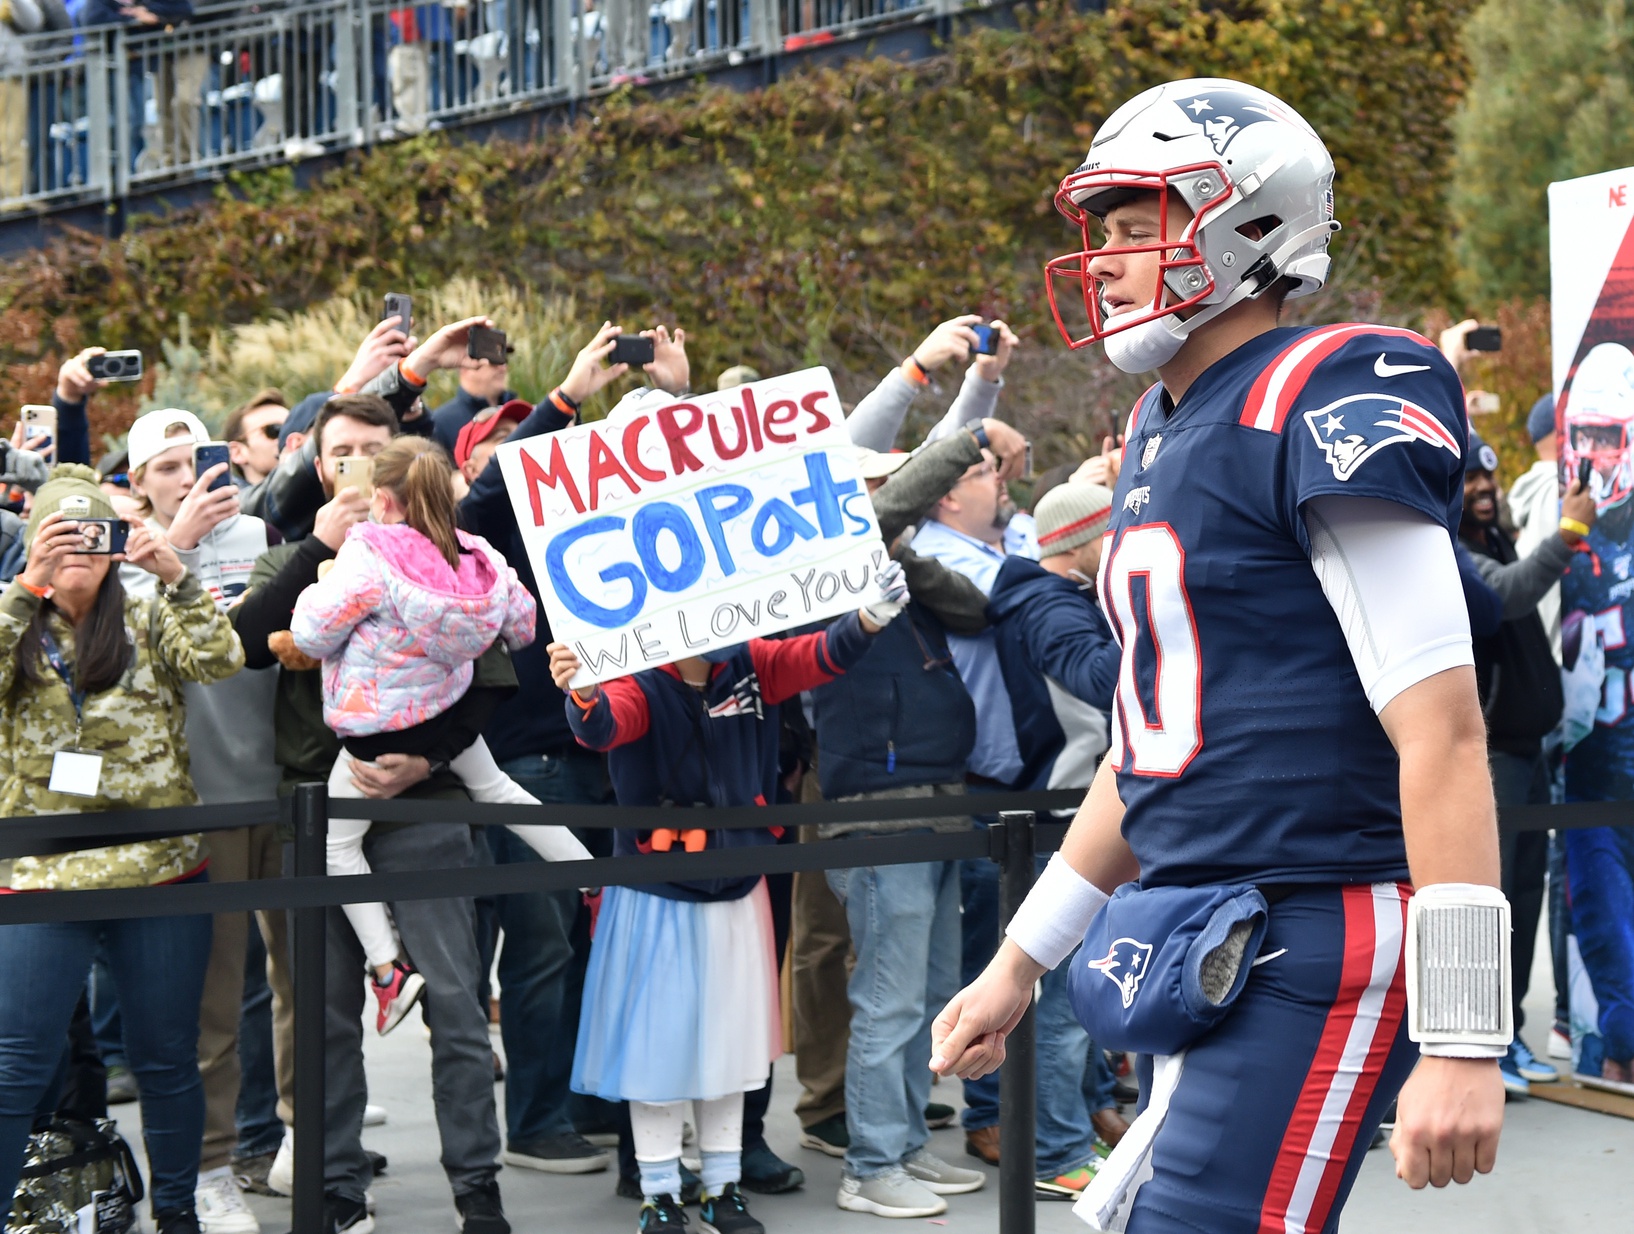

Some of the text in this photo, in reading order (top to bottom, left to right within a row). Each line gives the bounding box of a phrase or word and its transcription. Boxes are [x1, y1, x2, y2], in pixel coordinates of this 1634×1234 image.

[1609, 184, 1627, 208] NE
[574, 623, 669, 676] WE
[1096, 521, 1204, 778] 0
